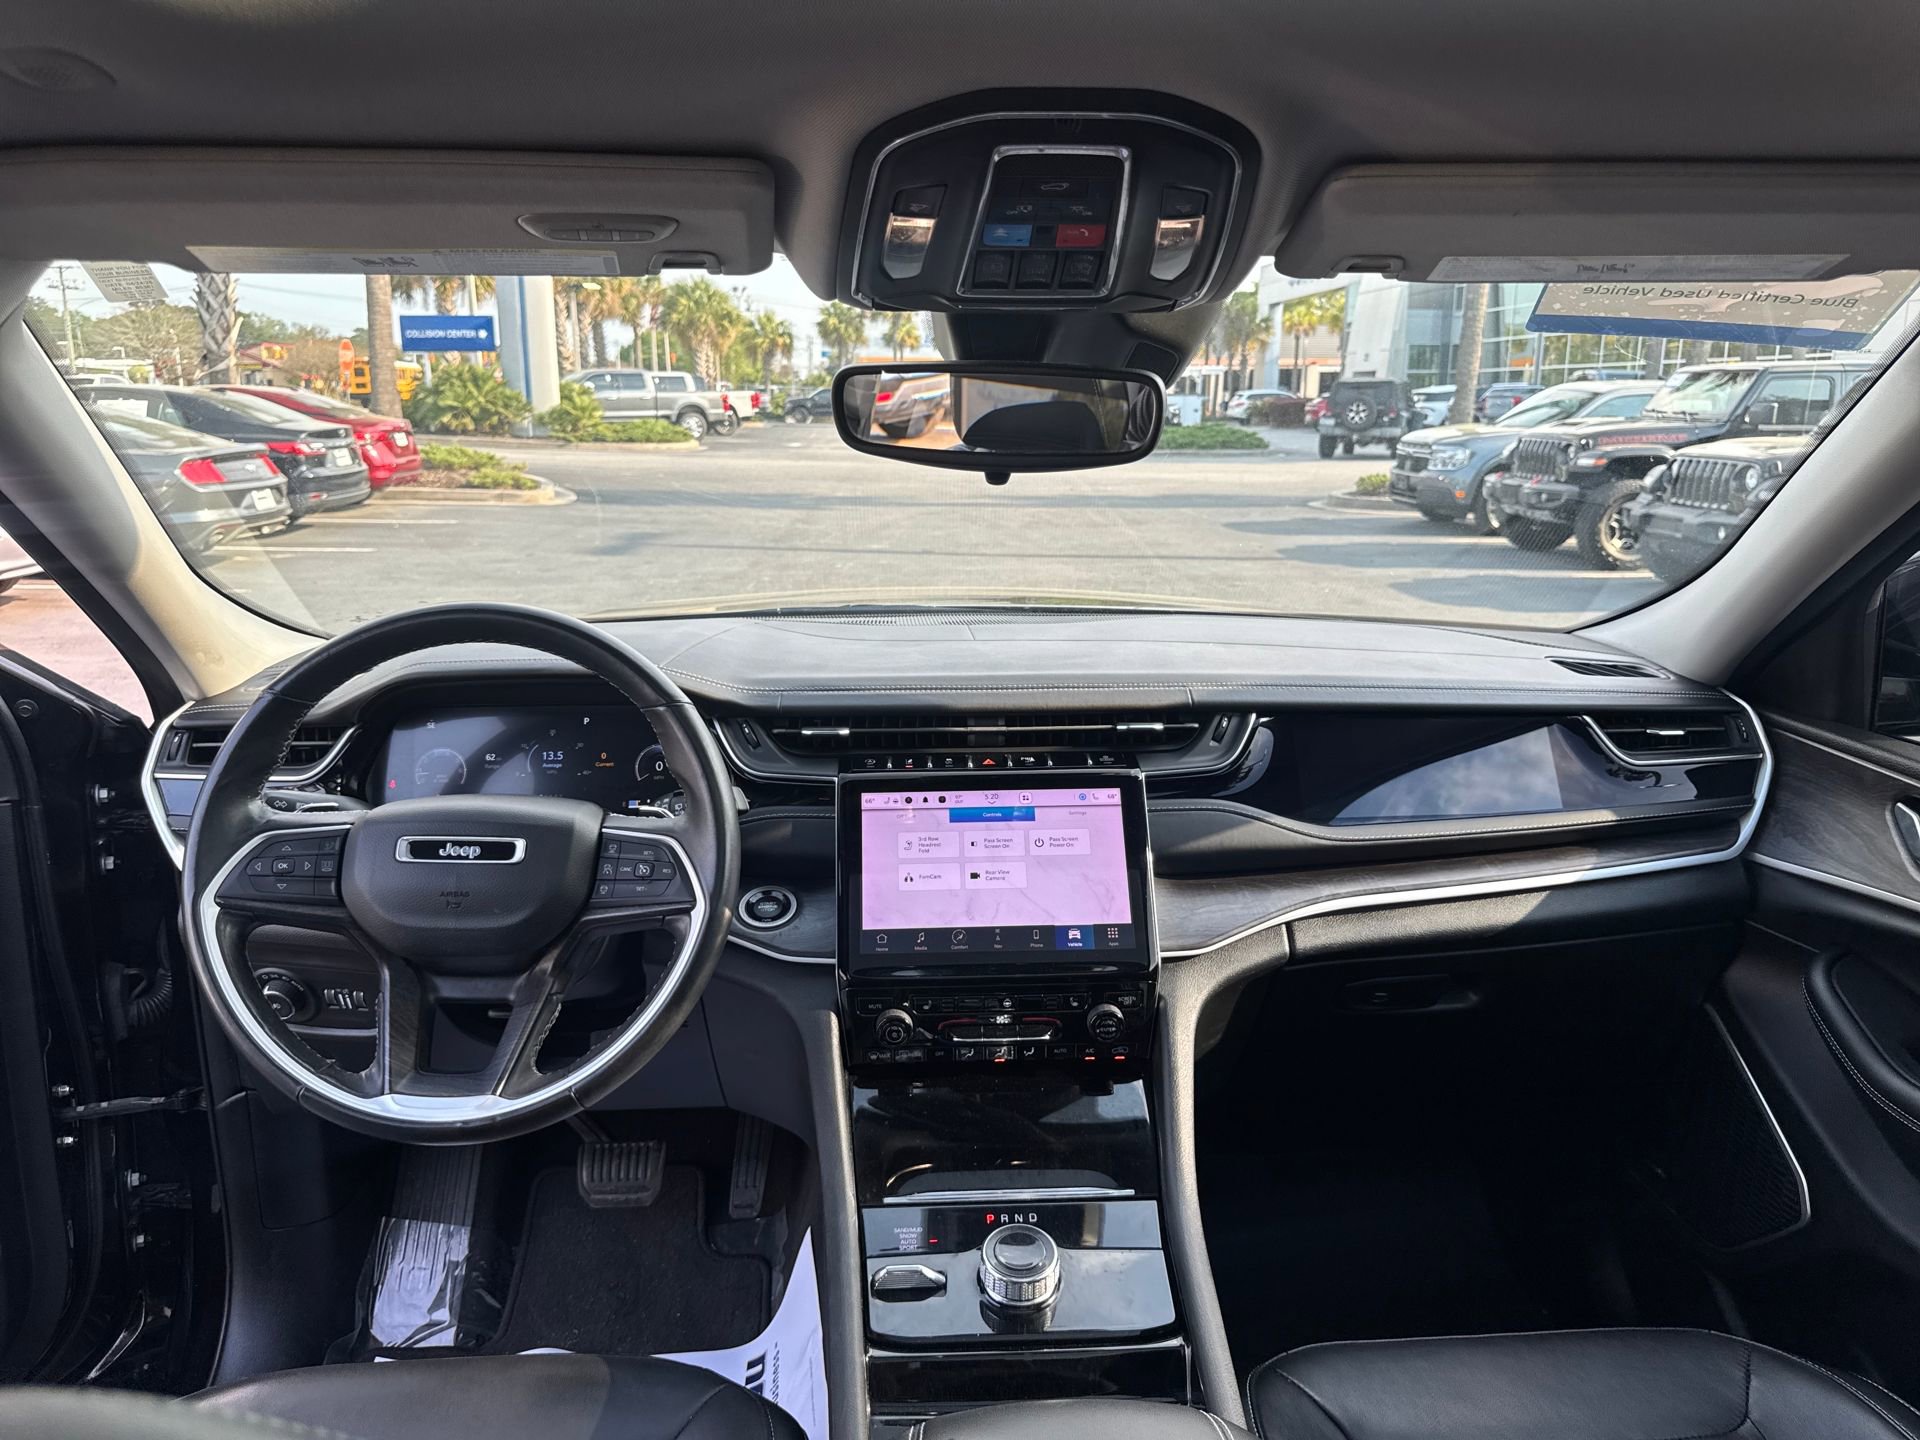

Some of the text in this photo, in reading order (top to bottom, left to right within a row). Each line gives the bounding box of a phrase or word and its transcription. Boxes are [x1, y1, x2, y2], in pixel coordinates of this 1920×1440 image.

[405, 329, 477, 339] COLLISION CENTER
[583, 717, 590, 725] P
[485, 753, 496, 761] 62
[542, 751, 564, 760] 13.5
[655, 761, 664, 771] 0
[438, 842, 481, 859] Jeep
[986, 1213, 1038, 1224] P R N D
